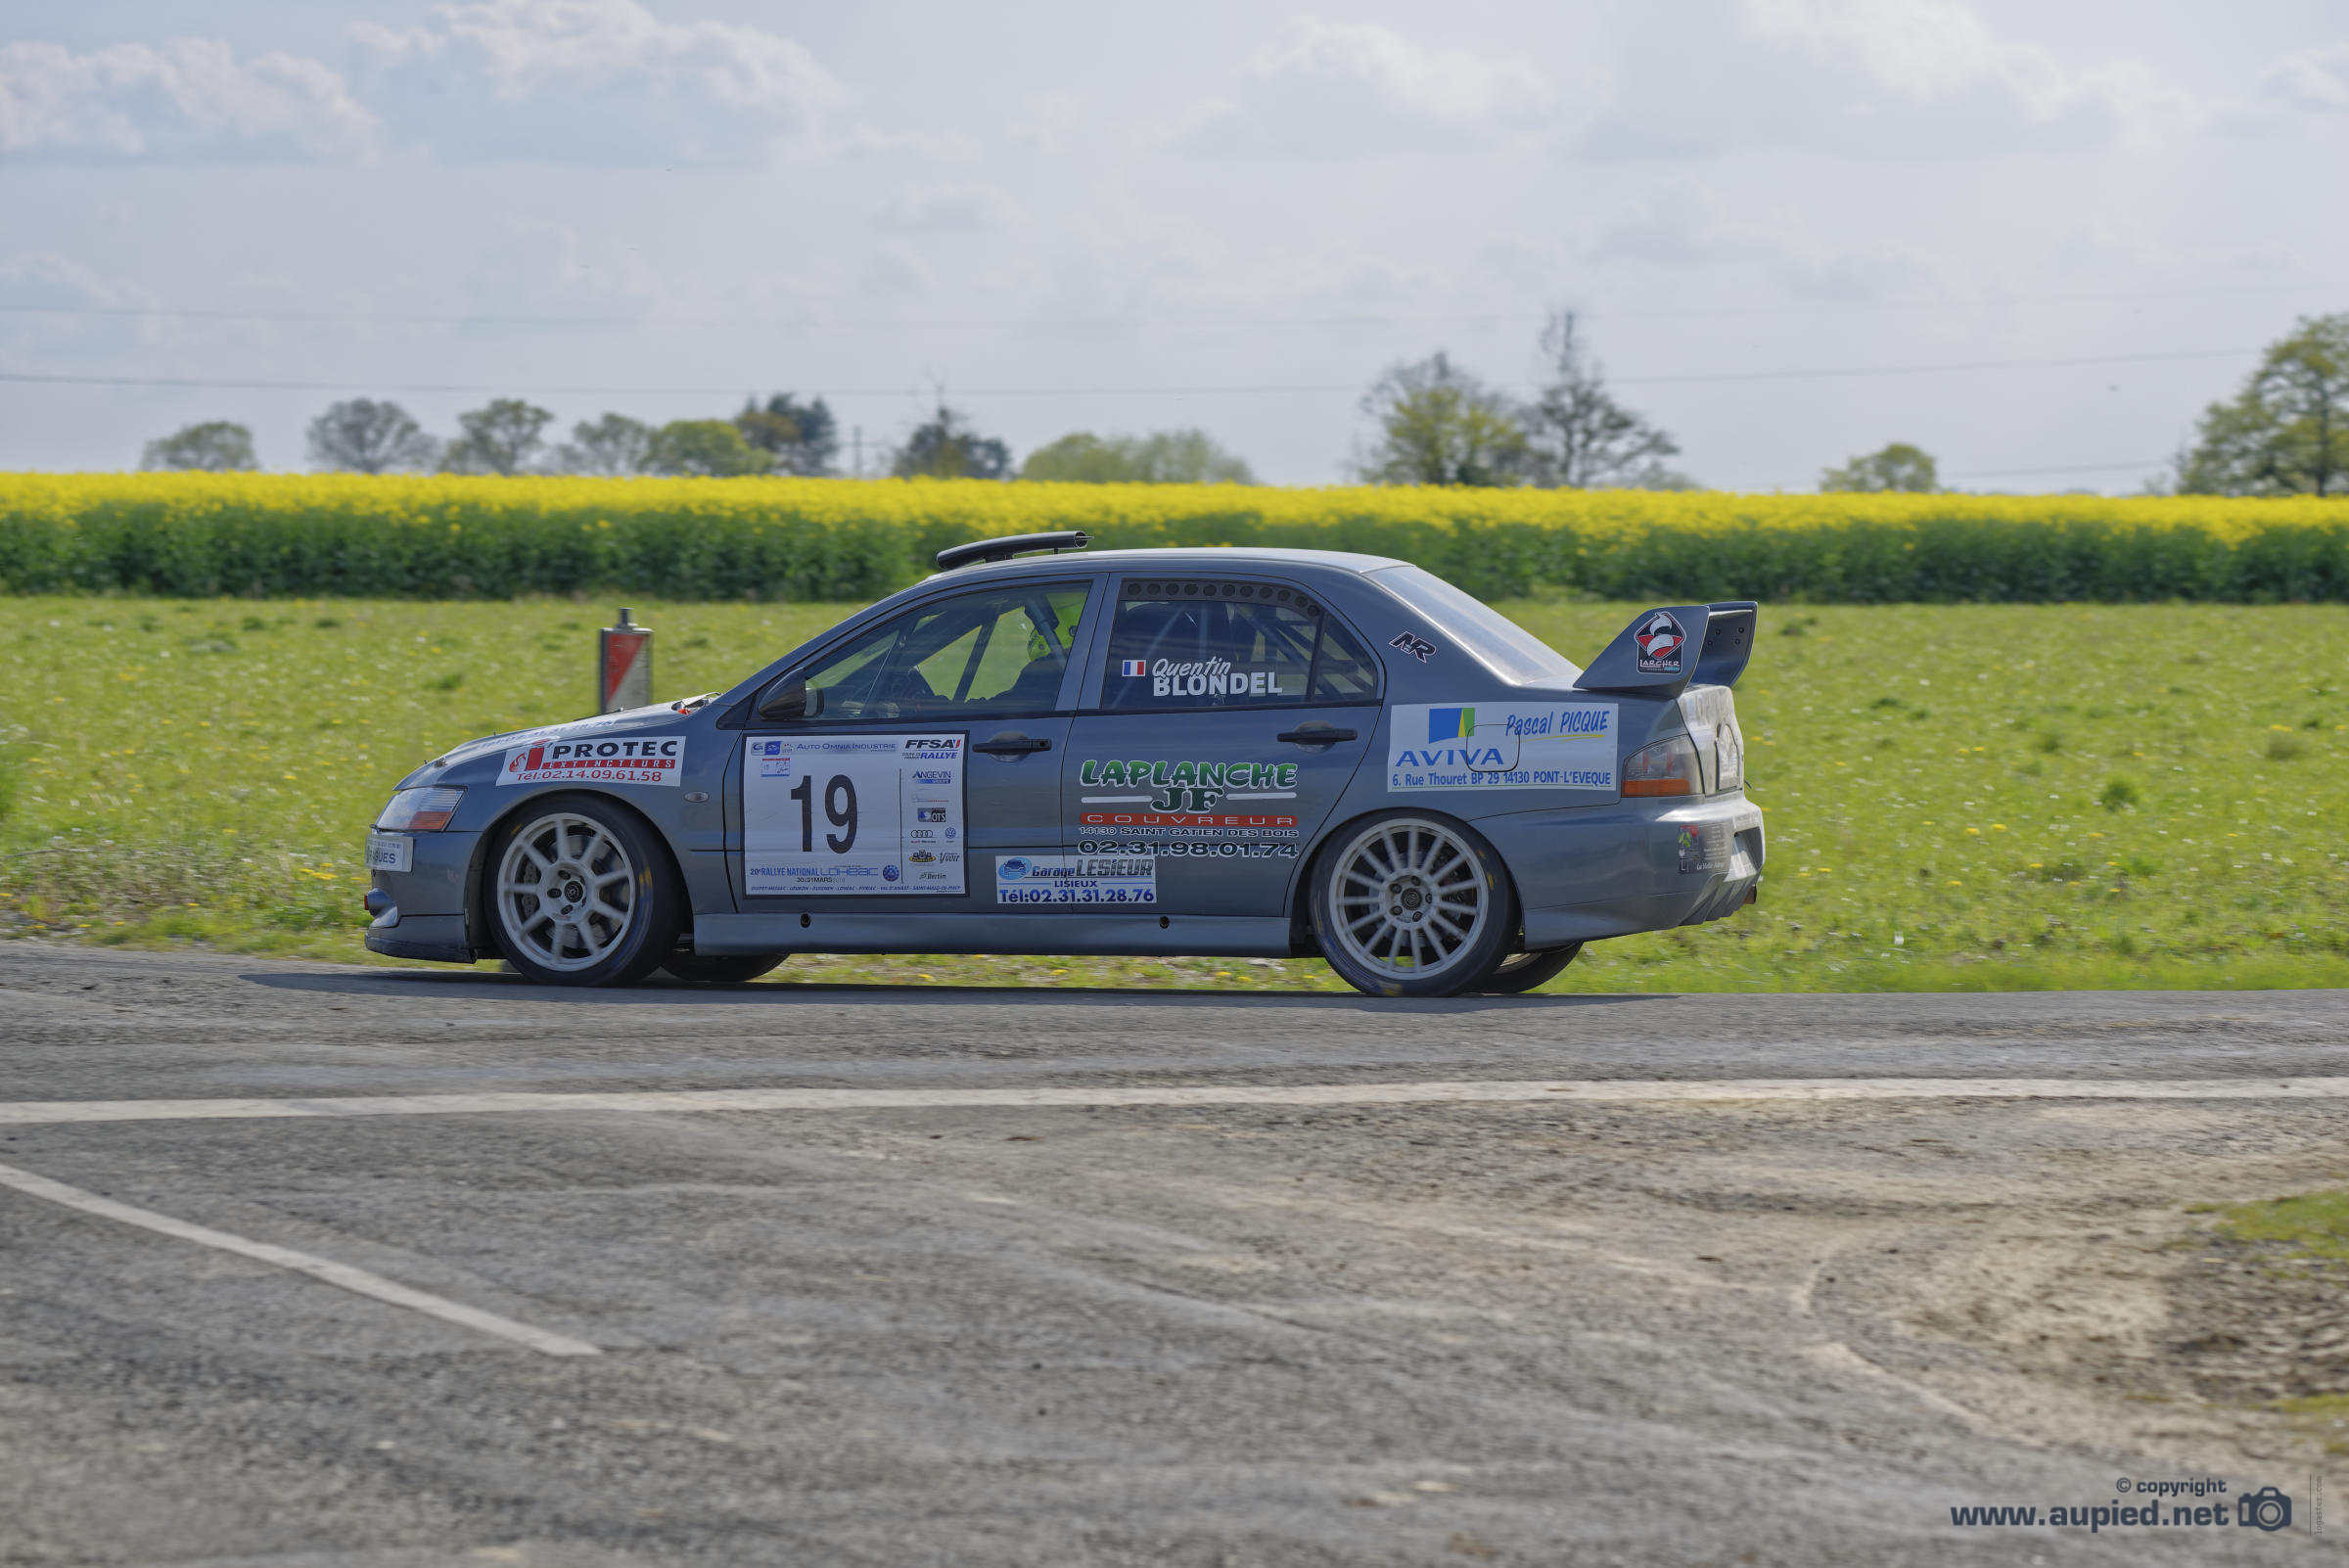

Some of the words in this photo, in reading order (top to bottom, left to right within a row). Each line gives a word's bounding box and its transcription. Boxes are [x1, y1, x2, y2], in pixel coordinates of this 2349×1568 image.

[1152, 656, 1231, 679] Quentin
[1153, 671, 1283, 697] BLONDEL
[1505, 712, 1553, 736] Pascal
[1560, 711, 1609, 733] PICQUE
[552, 741, 677, 759] PROTEC
[904, 739, 954, 749] FFSA
[549, 760, 672, 769] EXTINCTEURS
[1395, 748, 1504, 767] AVIVA
[912, 770, 951, 779] ANGEVIN
[1081, 761, 1298, 789] LAPLANCHE
[1405, 774, 1424, 785] Rue
[1429, 772, 1467, 785] Thouret
[1471, 772, 1484, 785] BP
[1487, 771, 1499, 784] 29
[1503, 771, 1529, 784] 14130
[1534, 770, 1611, 786] PONT-L'EVEQUE
[1151, 786, 1223, 812] JF
[791, 774, 857, 854] 19
[1086, 814, 1292, 825] COUVREUR
[1121, 827, 1166, 836] SAINT
[1169, 828, 1222, 837] GATIEN
[1262, 829, 1299, 838] BOIS
[1078, 840, 1299, 858] 02.31.98.01.74
[761, 867, 786, 876] RALLYE
[786, 867, 819, 876] NATIONAL
[1032, 865, 1075, 877] Garage
[999, 889, 1154, 902] Tél:02.31.31.28.76
